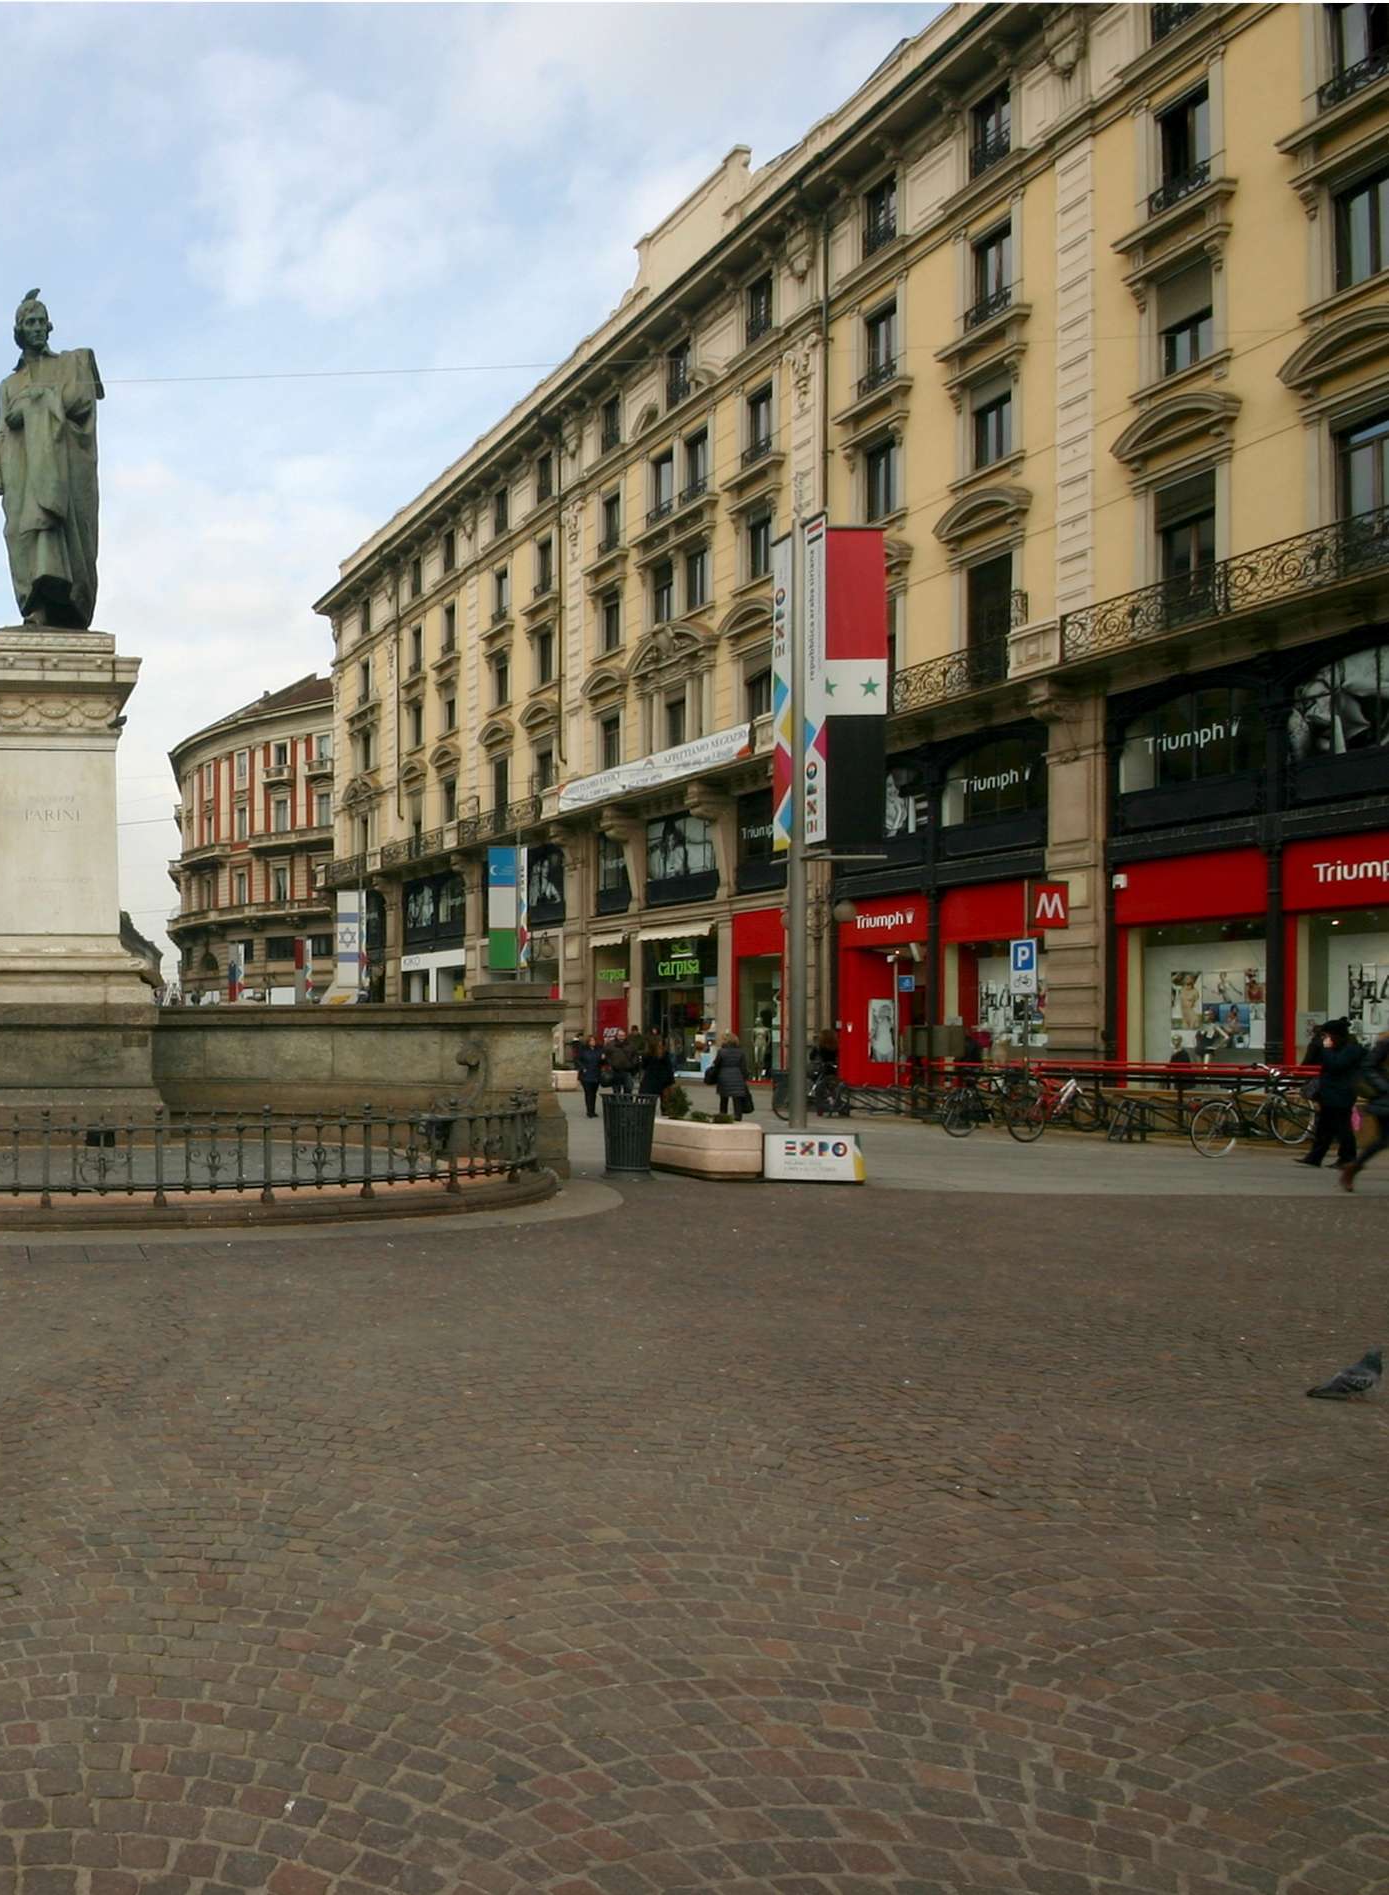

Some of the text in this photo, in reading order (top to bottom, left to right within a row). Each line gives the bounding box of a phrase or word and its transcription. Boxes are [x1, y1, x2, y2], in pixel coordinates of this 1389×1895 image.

[1144, 721, 1225, 755] Triumph
[961, 769, 1019, 794] Triumph
[24, 808, 81, 821] PARINI
[741, 824, 773, 840] Triump
[1312, 860, 1389, 883] Triump
[1035, 892, 1065, 919] M
[855, 912, 904, 930] Triumph
[1016, 945, 1030, 968] P
[658, 959, 701, 981] carpisa
[785, 1141, 848, 1157] EXPO
